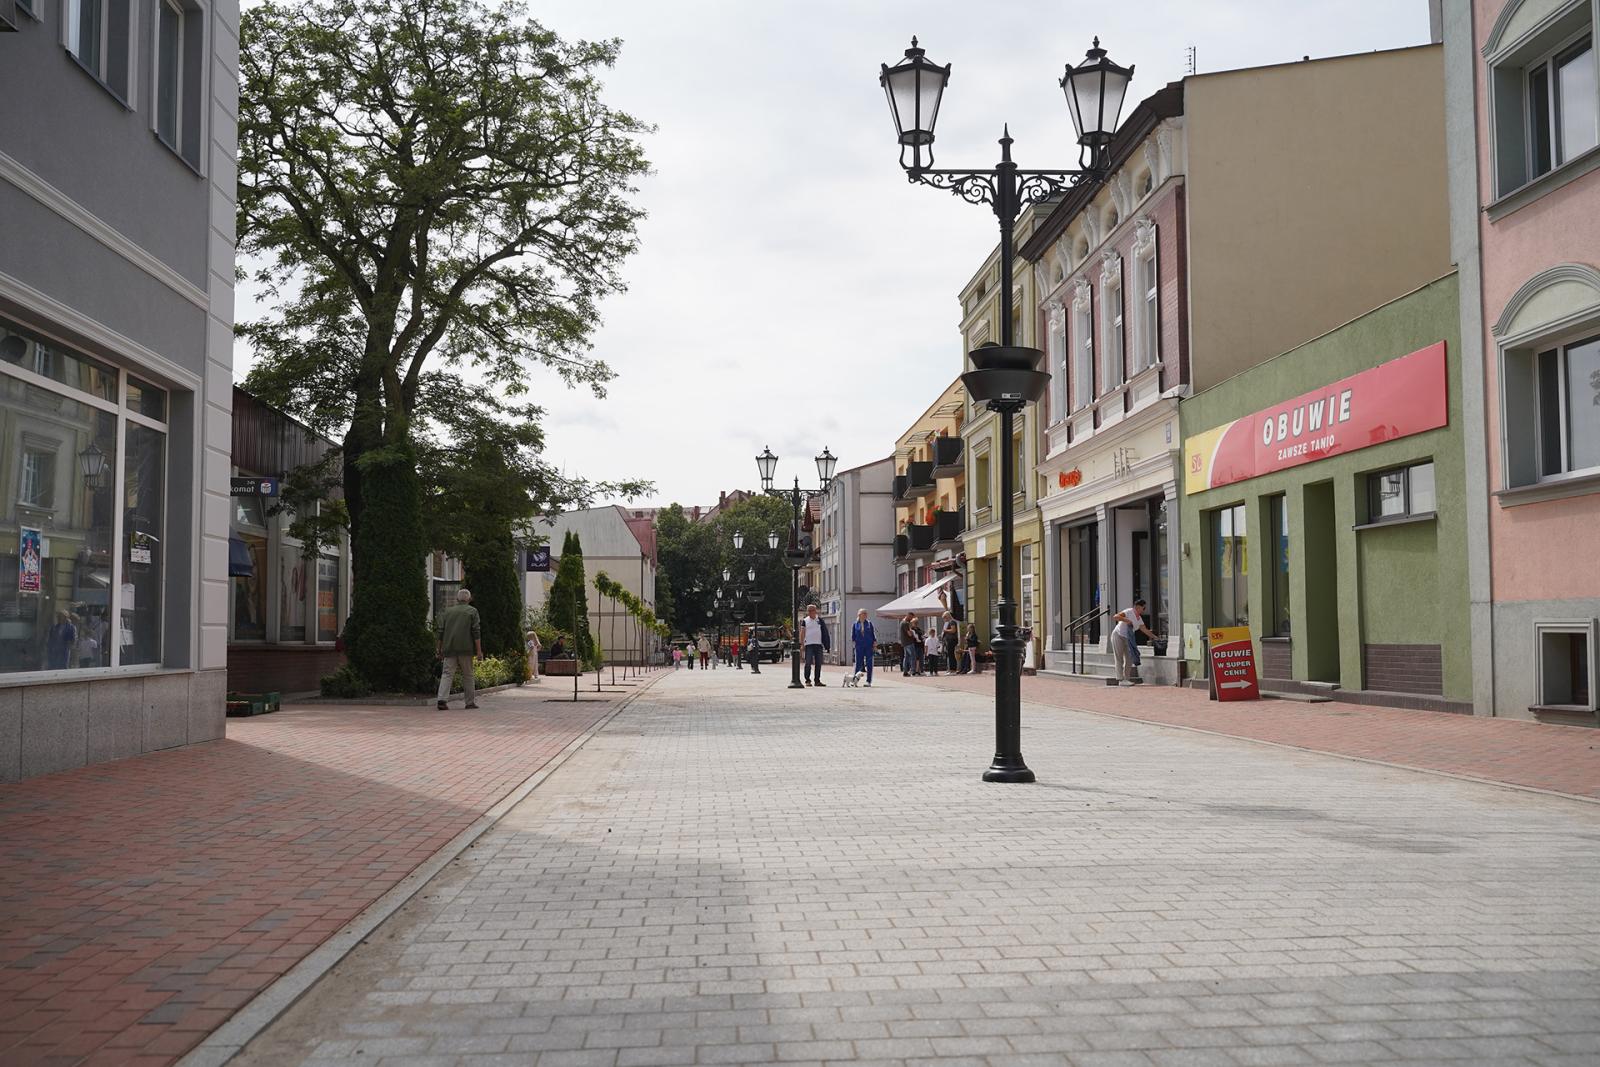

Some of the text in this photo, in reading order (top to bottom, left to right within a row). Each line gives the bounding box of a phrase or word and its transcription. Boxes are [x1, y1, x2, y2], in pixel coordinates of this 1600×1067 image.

[1263, 389, 1352, 448] OBUWIE
[1278, 434, 1335, 461] ZAWSZE TANIO
[1213, 649, 1252, 659] OBUWIE
[1226, 660, 1251, 668] SUPER
